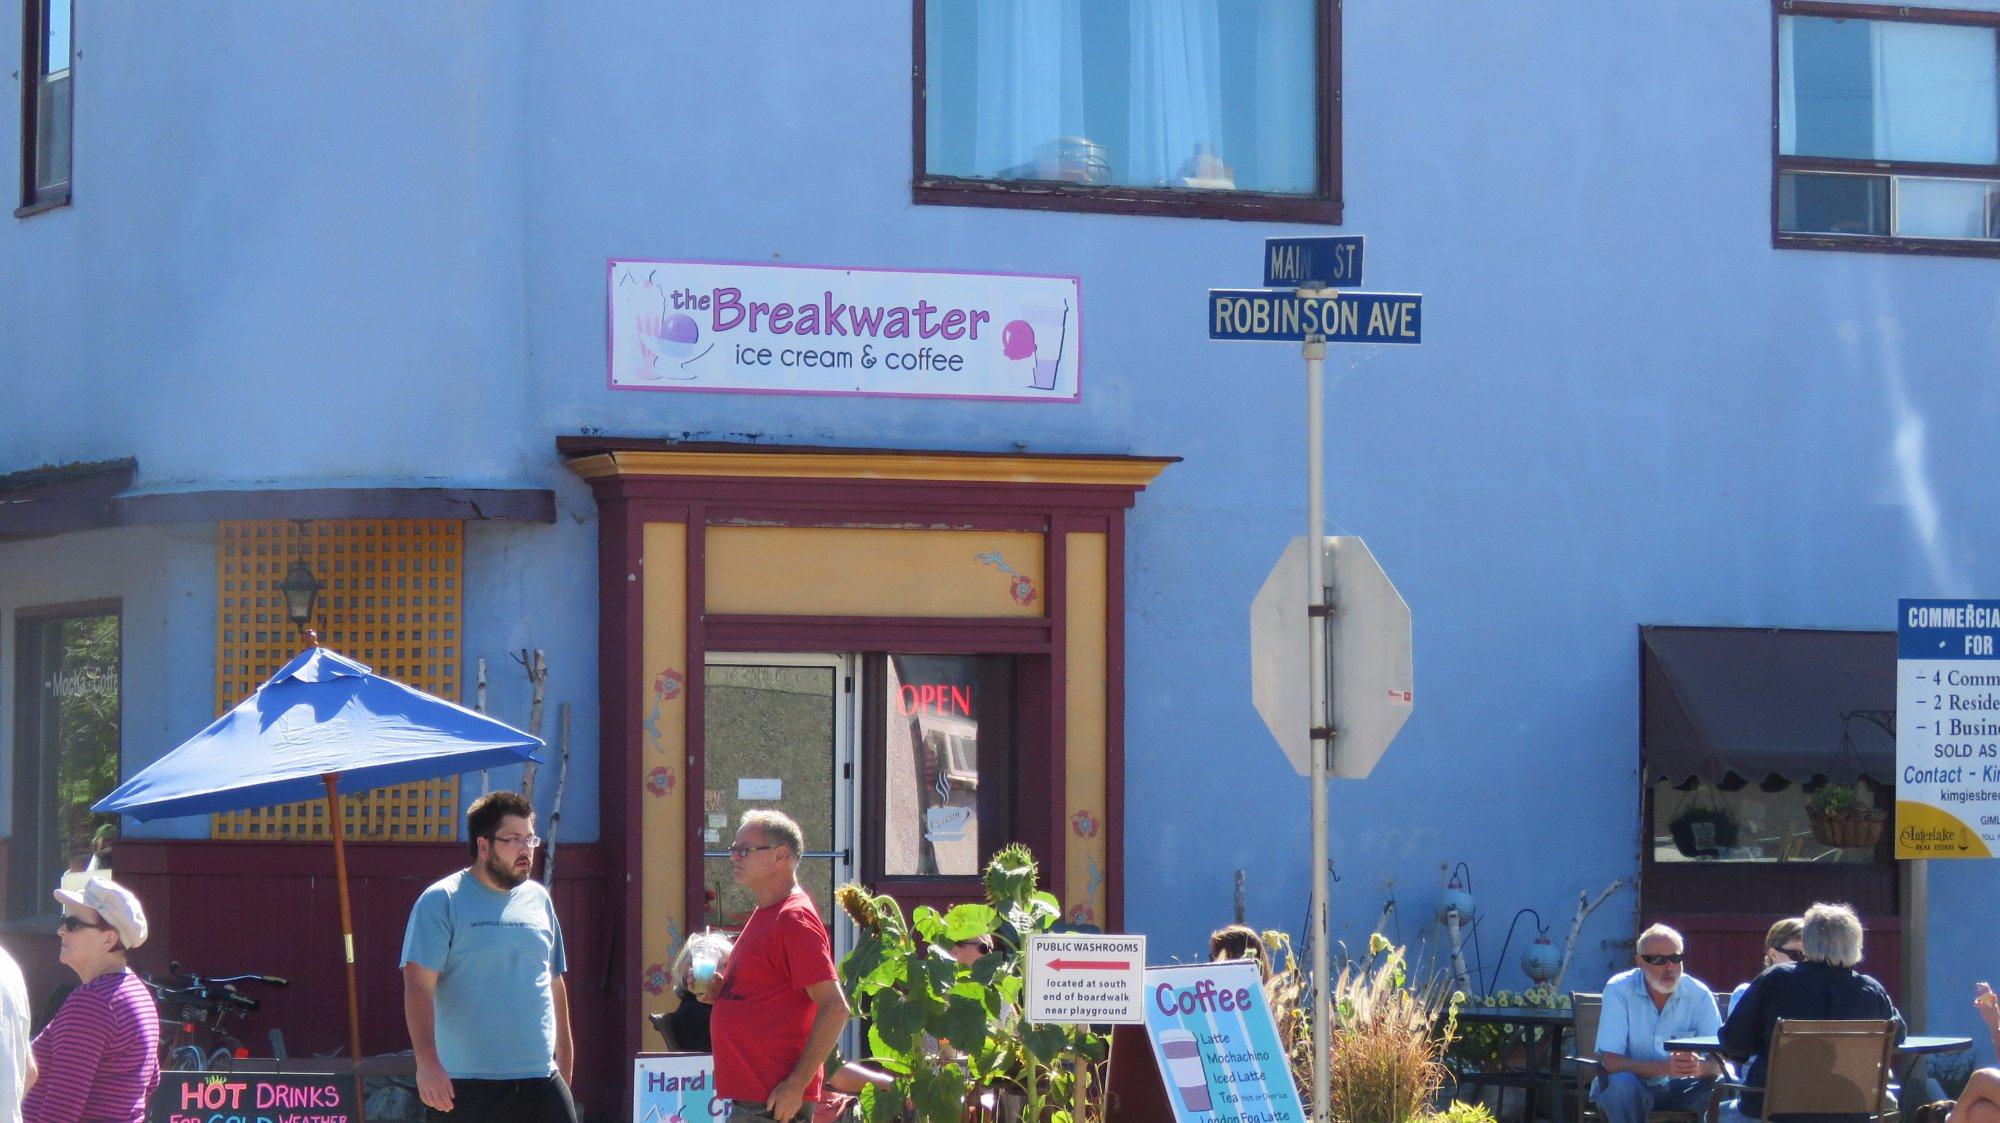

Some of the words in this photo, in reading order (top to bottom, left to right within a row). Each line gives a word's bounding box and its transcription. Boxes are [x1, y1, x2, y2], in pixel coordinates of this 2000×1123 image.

[1334, 243, 1355, 279] ST
[670, 288, 711, 311] the
[711, 287, 990, 340] Breakwater
[1216, 298, 1358, 335] ROBINSON
[1367, 301, 1416, 337] AVE
[735, 344, 773, 366] ice
[780, 347, 853, 368] cream
[861, 345, 878, 369] &
[885, 347, 964, 371] coffee
[1908, 606, 2000, 628] COMMERCIA
[1964, 635, 1993, 655] FOR
[1933, 670, 1941, 685] 4
[1947, 670, 2000, 686] Comm
[896, 684, 972, 718] OPEN
[1934, 694, 1942, 710] 2
[1949, 693, 2000, 710] Reside
[1935, 720, 1941, 736] 1
[1949, 718, 2000, 736] Busin
[1934, 744, 1973, 758] SOLD
[1978, 744, 1997, 758] AS
[1904, 766, 1962, 784] Contact
[1036, 942, 1071, 952] PUBLIC
[1073, 943, 1139, 952] WASHROOMS
[1047, 979, 1083, 988] located
[1086, 980, 1096, 988] at
[1099, 980, 1127, 988] south
[1043, 993, 1061, 1001] end
[1064, 993, 1074, 1001] of
[1077, 993, 1130, 1002] boardwalk
[1156, 979, 1252, 1016] Coffee
[1045, 1007, 1067, 1015] near
[1070, 1006, 1127, 1017] playground
[1200, 1033, 1231, 1045] Latte
[1207, 1049, 1269, 1064] Mochachino
[648, 1070, 705, 1092] Hard
[1213, 1071, 1237, 1084] Iced
[1237, 1070, 1266, 1083] Latte
[181, 1083, 247, 1110] HOT
[256, 1083, 340, 1109] DRINKS
[1219, 1092, 1239, 1104] Tea
[1240, 1112, 1261, 1123] Fog
[1261, 1111, 1290, 1122] Latte
